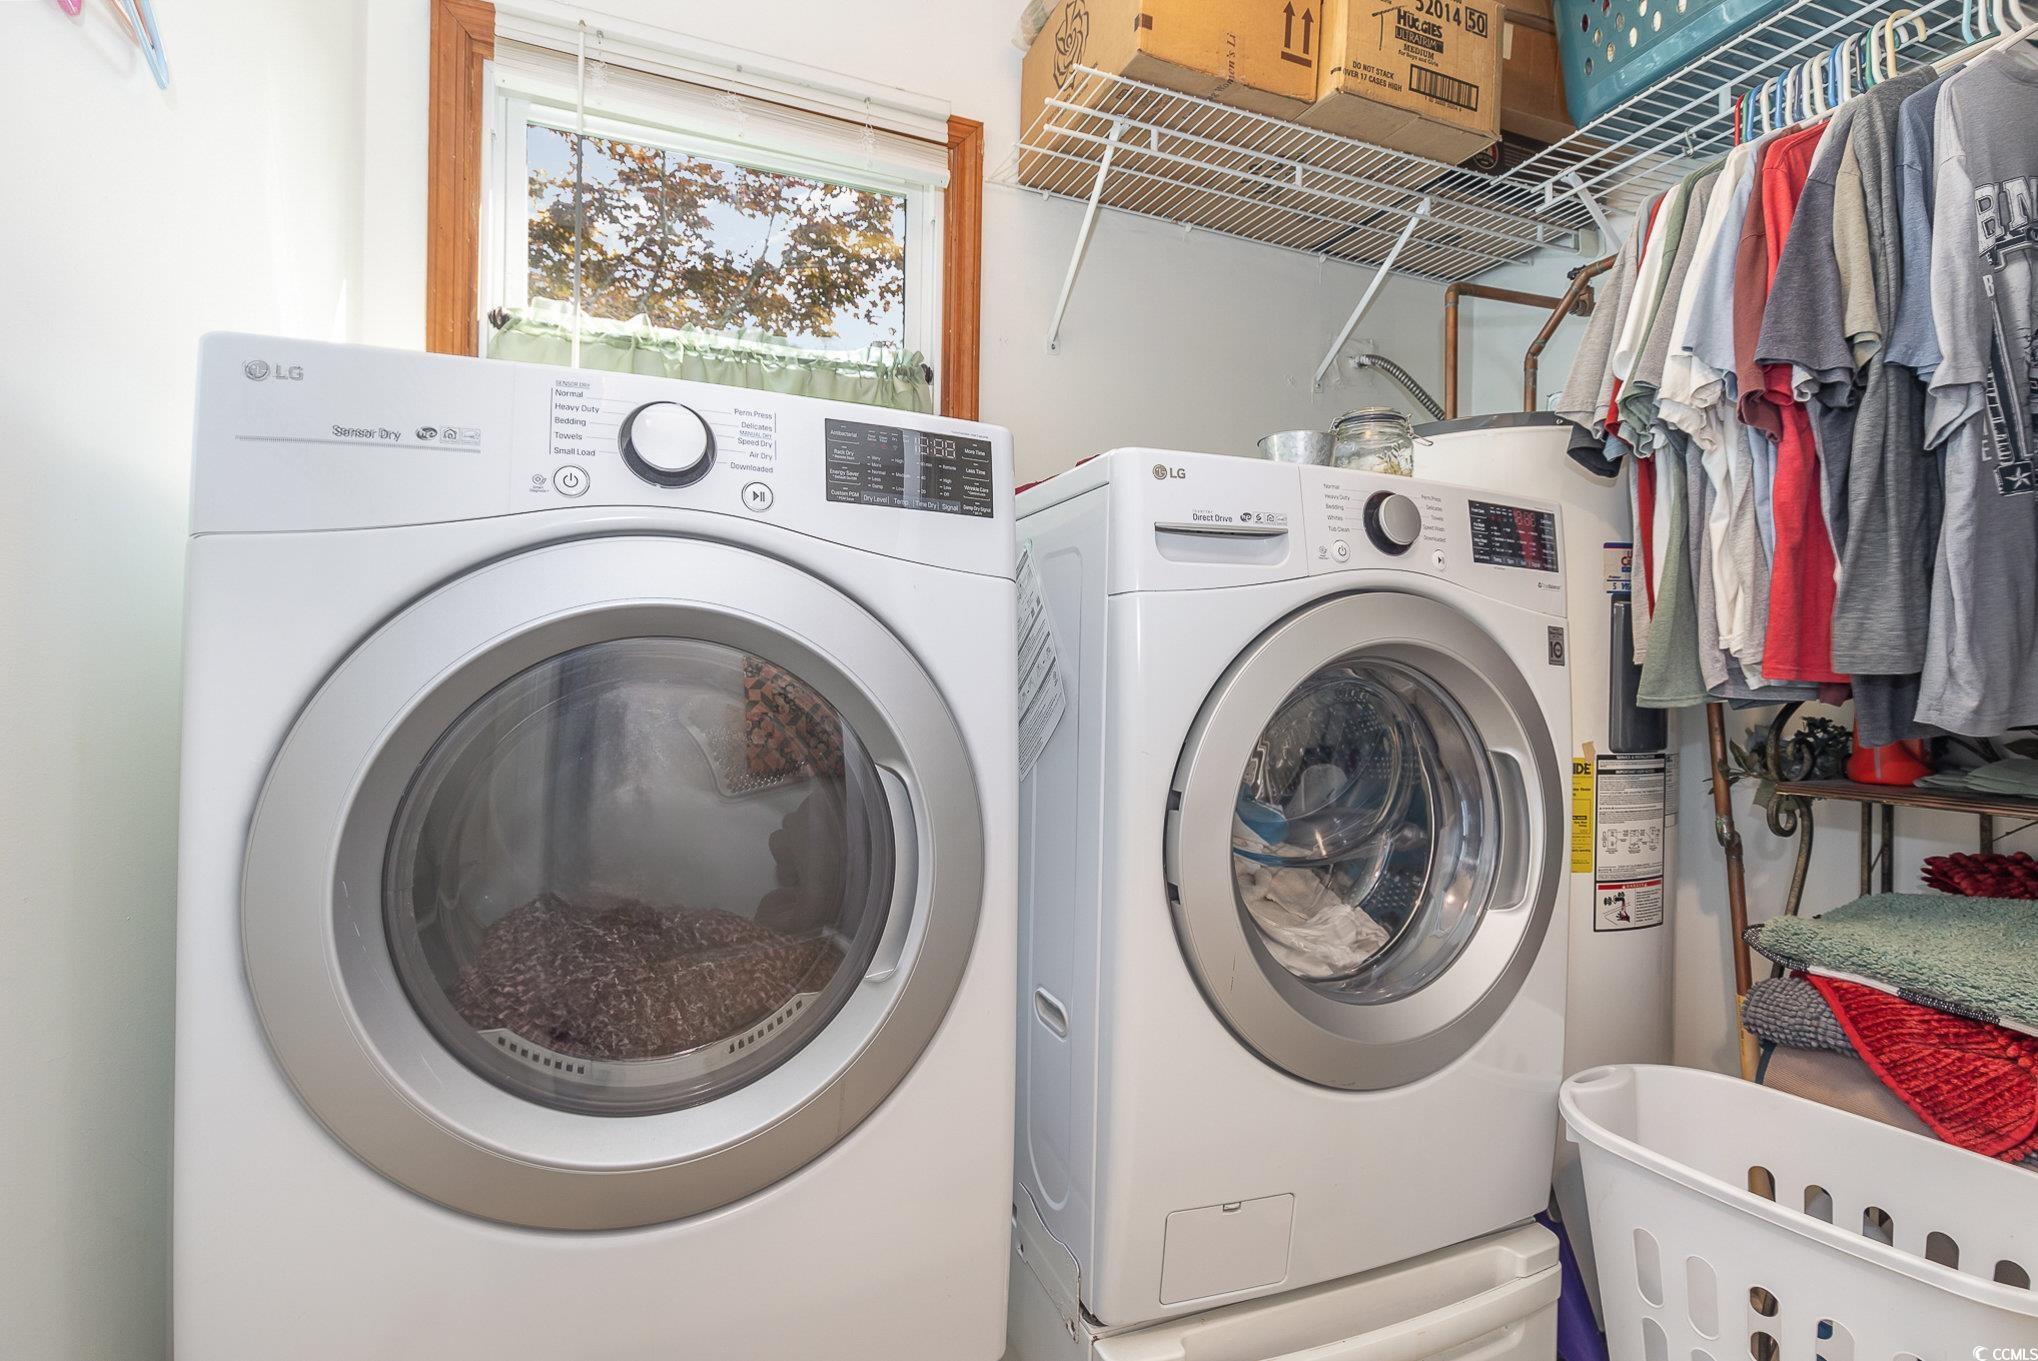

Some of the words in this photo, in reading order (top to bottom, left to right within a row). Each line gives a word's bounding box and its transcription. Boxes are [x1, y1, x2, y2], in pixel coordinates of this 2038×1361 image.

[1468, 11, 1486, 34] 50
[1403, 44, 1435, 60] MEDIUM
[1352, 60, 1362, 70] DO
[1362, 63, 1375, 74] NOT
[1376, 67, 1395, 80] STACK
[1343, 67, 1359, 78] OVER
[1360, 73, 1368, 81] 17
[1369, 74, 1387, 87] CASES
[1388, 80, 1402, 92] HIGH
[554, 389, 584, 398] Normal
[554, 402, 580, 412] Heavy
[581, 404, 600, 413] Duty
[734, 408, 752, 417] Perm
[753, 410, 773, 420] Press
[554, 417, 587, 427] Bedding
[741, 421, 773, 432] Delicates
[332, 424, 376, 439] Sensor
[378, 427, 402, 443] Dry
[554, 431, 583, 440] Towels
[737, 437, 760, 446] Speed
[760, 440, 773, 448] Dry
[554, 447, 576, 455] Small
[577, 448, 596, 456] Load
[760, 452, 773, 461] Dry
[846, 449, 855, 457] Dry
[730, 461, 774, 473] Downloaded
[1169, 467, 1186, 479] LG
[915, 500, 927, 508] Time
[927, 501, 937, 509] Dry
[942, 503, 959, 512] Signal
[1325, 503, 1344, 511] Bedding
[1192, 512, 1214, 522] Direct
[1215, 514, 1233, 523] Drive
